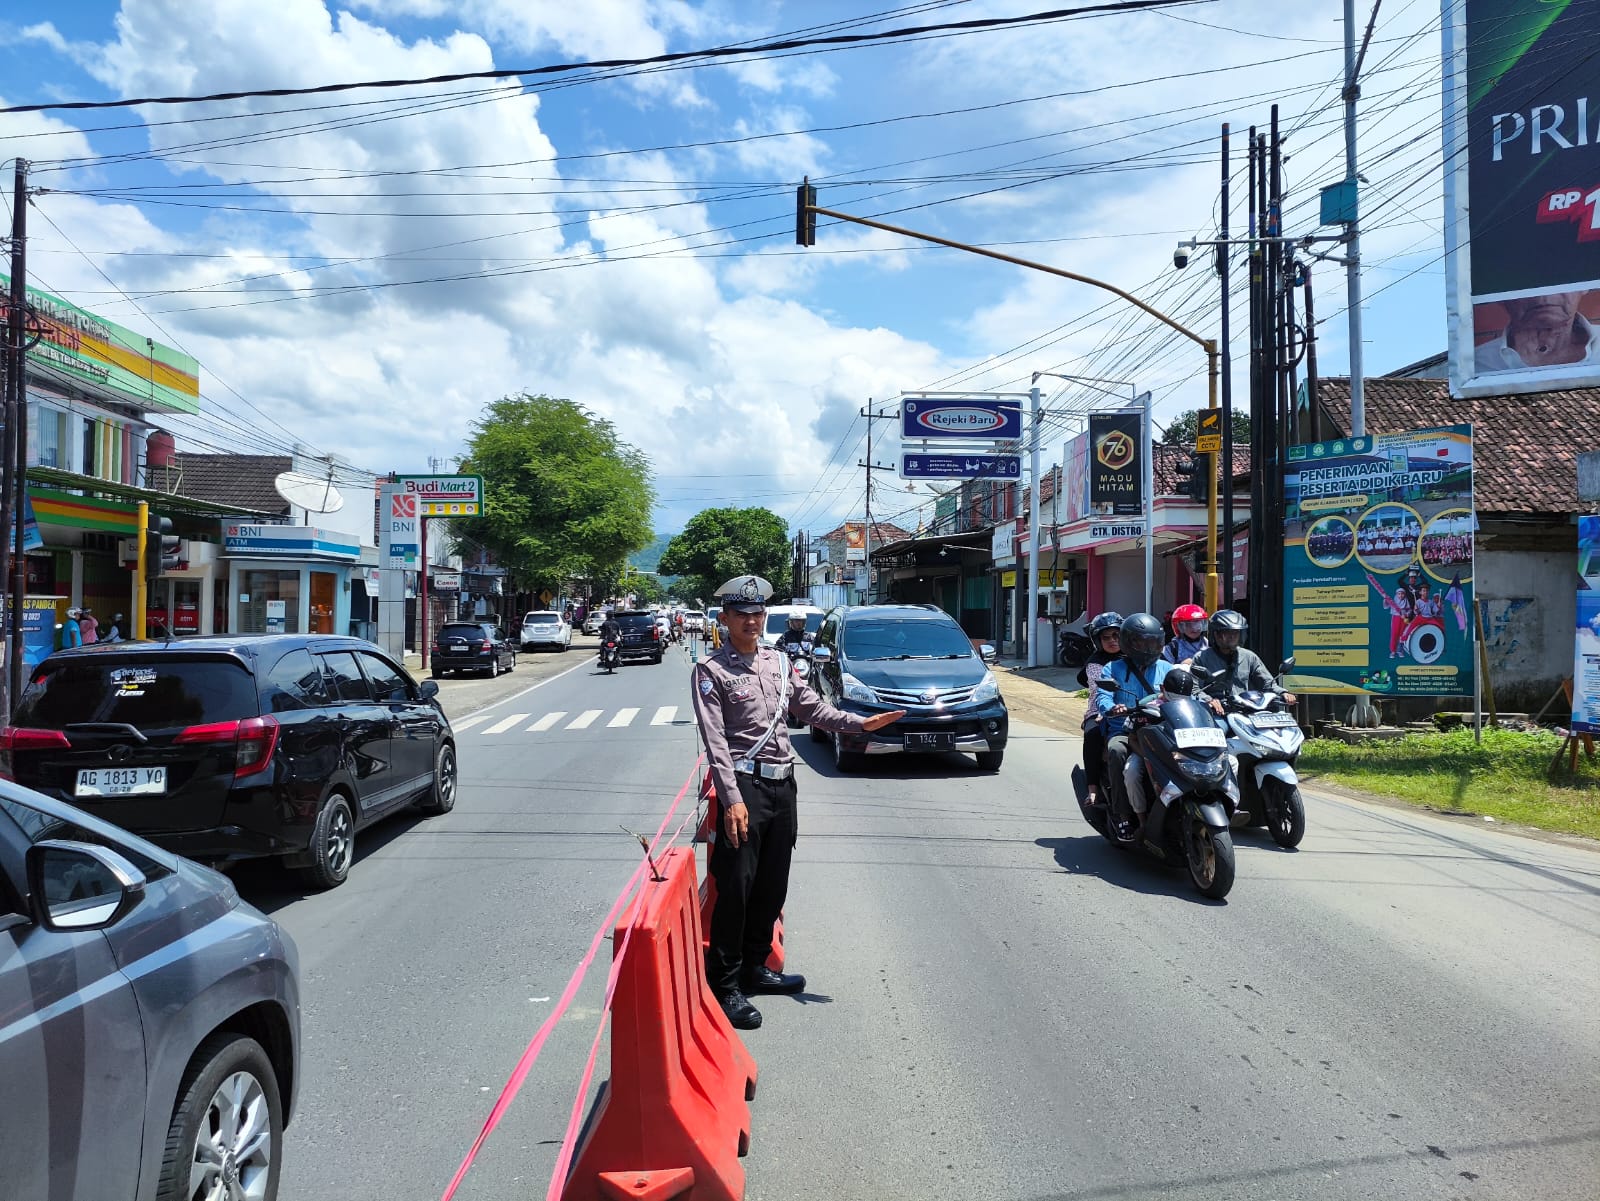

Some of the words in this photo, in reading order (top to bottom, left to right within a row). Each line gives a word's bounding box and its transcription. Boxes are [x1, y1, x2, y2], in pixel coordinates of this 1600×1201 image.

[1492, 97, 1600, 161] PRI
[1549, 191, 1581, 211] RP
[932, 414, 967, 426] Rejeki
[969, 414, 996, 424] Baru
[1105, 435, 1126, 461] 76
[1100, 474, 1132, 482] MADU
[1300, 461, 1391, 482] PENERIMAAN
[405, 481, 438, 492] Budi
[440, 481, 466, 492] Mart
[468, 482, 475, 492] 2
[1300, 480, 1356, 496] PESERTA
[1359, 474, 1399, 490] DIDIK
[1401, 471, 1442, 486] BARU
[240, 527, 262, 536] BNI
[392, 522, 414, 532] BNI
[1112, 526, 1141, 535] DISTRO
[80, 771, 97, 785] AG
[104, 770, 137, 785] 1813
[147, 769, 162, 784] YO
